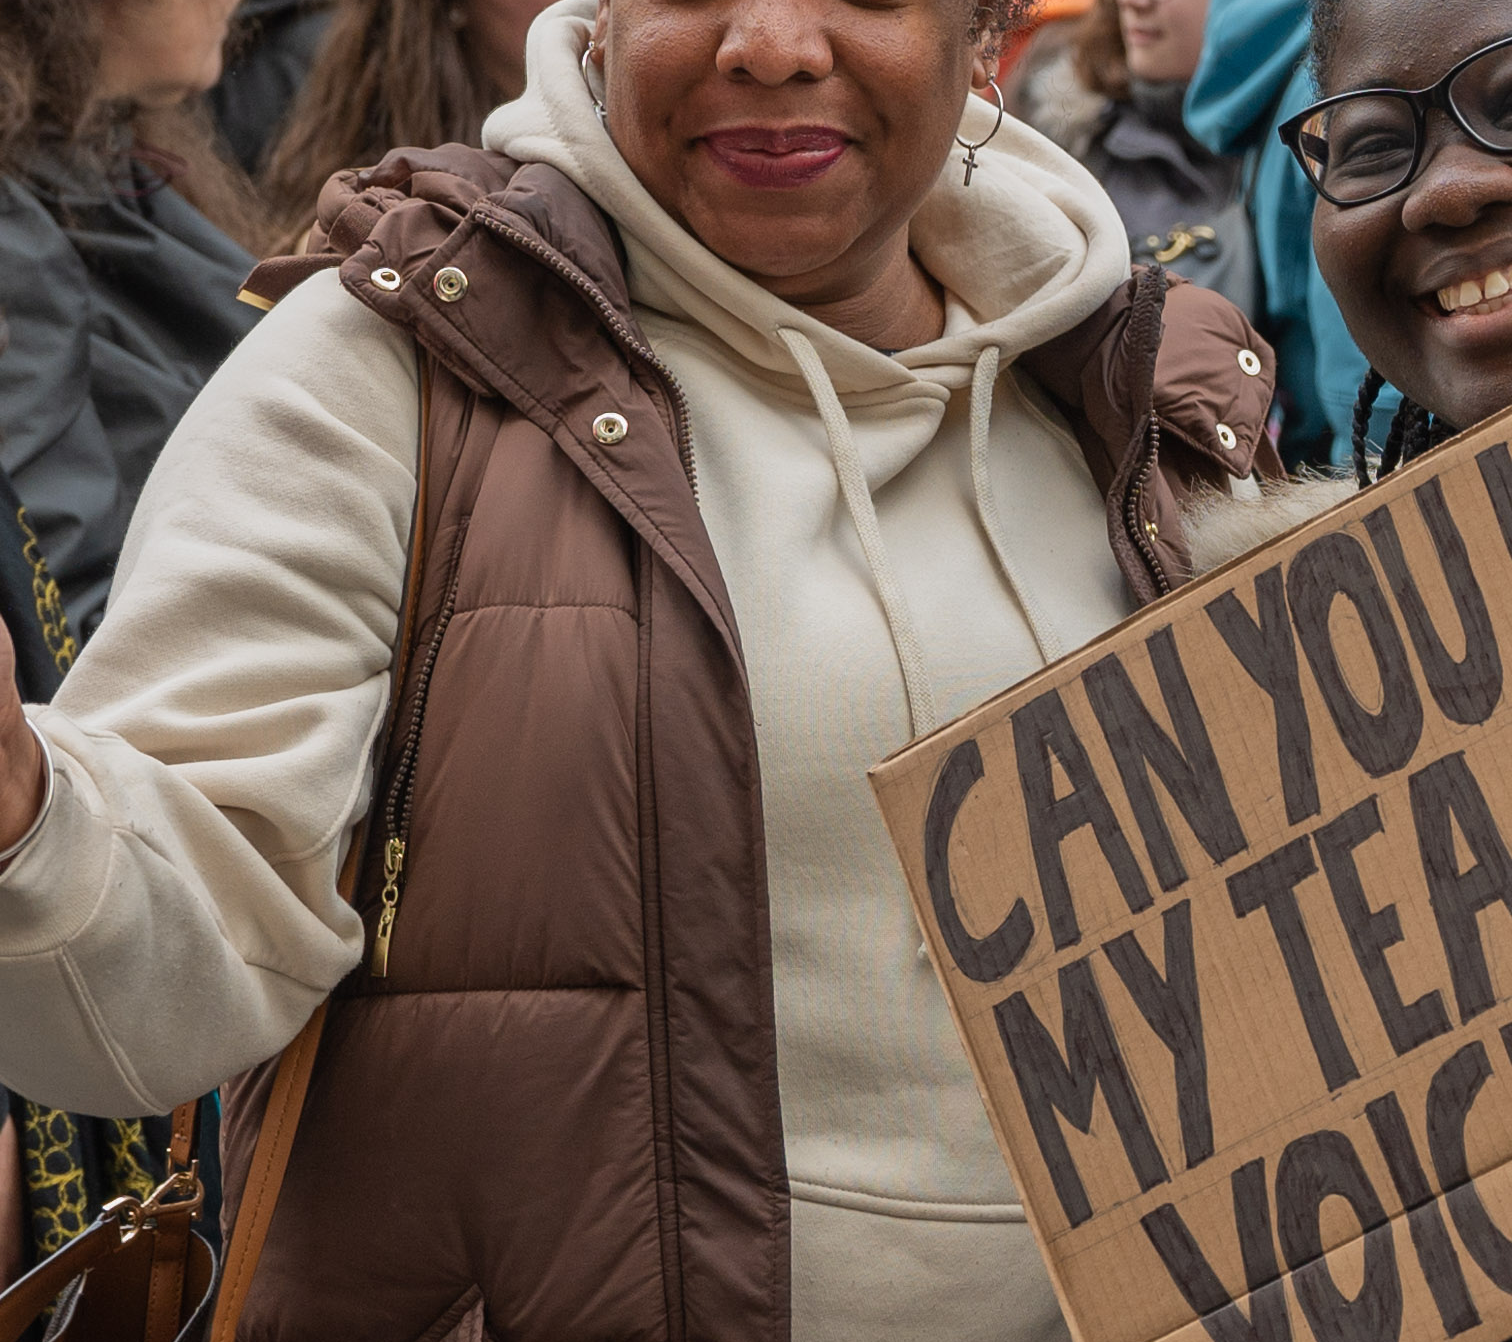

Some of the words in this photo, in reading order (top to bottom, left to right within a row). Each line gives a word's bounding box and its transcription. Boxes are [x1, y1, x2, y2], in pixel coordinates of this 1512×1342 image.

[922, 623, 1252, 985] CAN
[1203, 473, 1508, 819] YOU
[993, 898, 1216, 1229] MY
